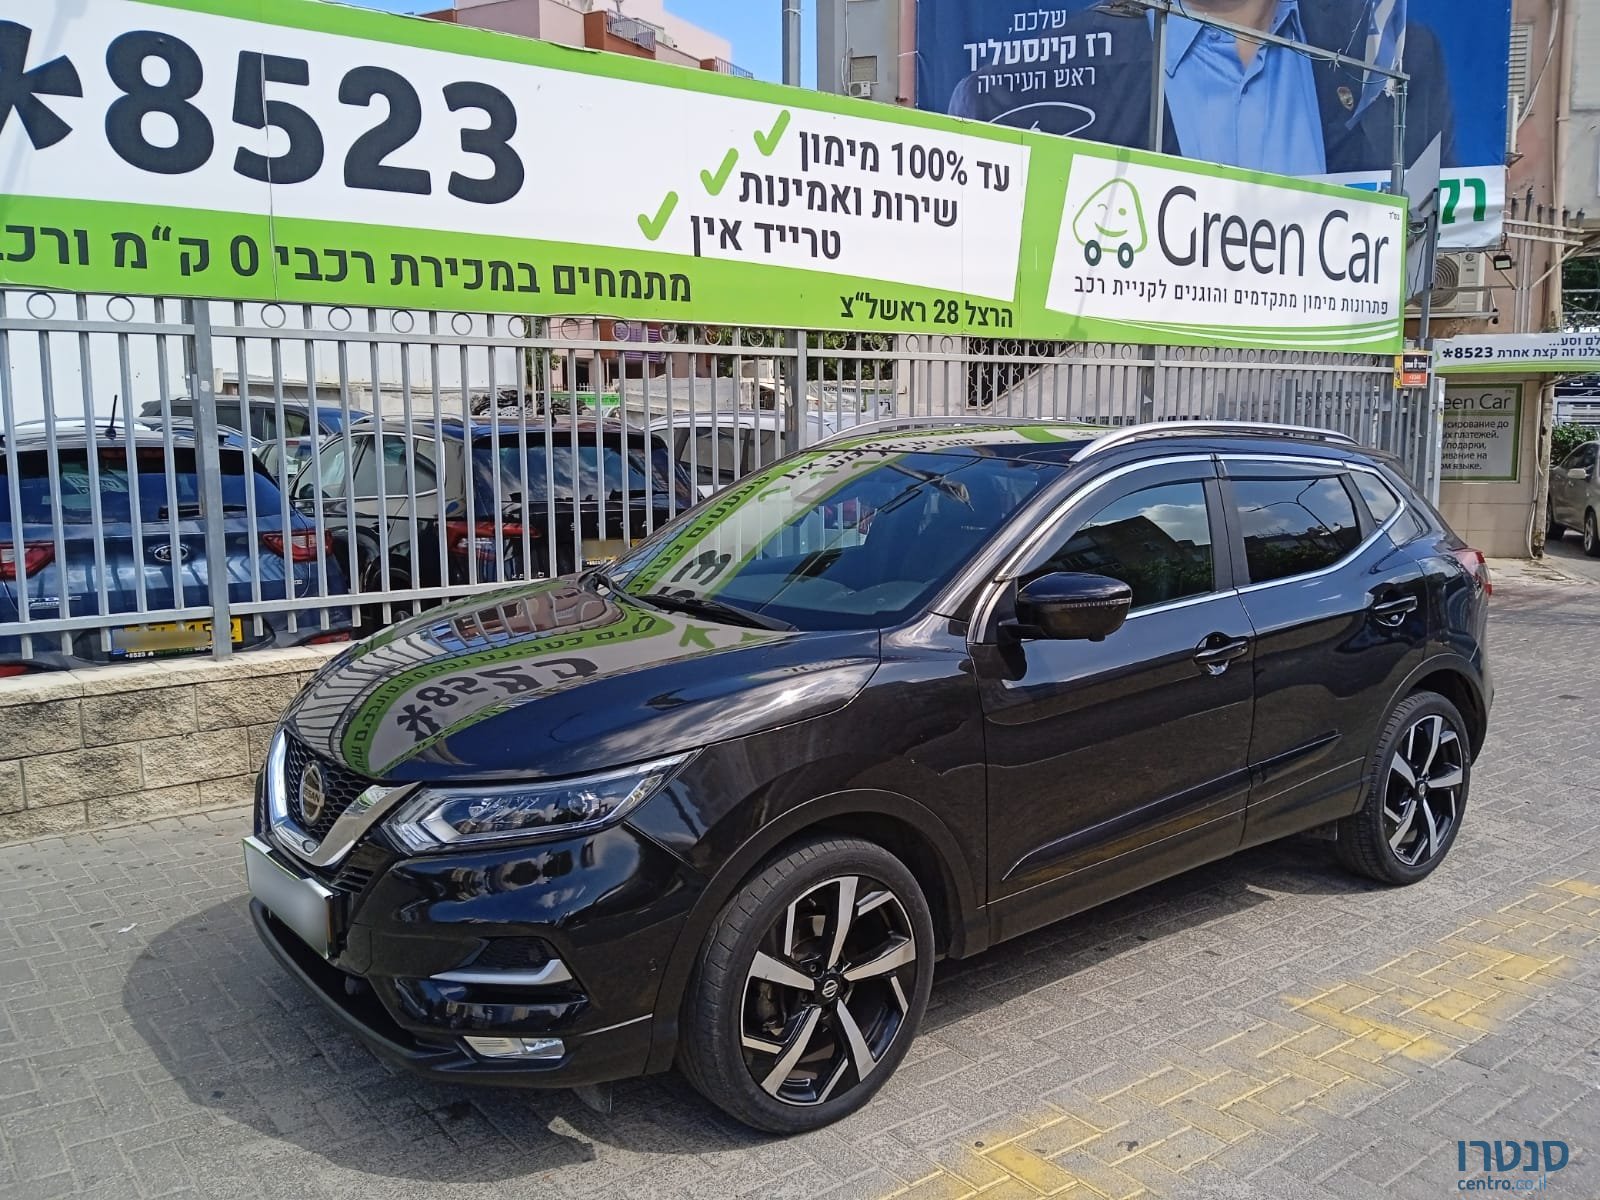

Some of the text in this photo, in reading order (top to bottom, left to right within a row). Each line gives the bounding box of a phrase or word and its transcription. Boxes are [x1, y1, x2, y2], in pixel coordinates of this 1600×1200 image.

[1008, 9, 1066, 34] שלכם,
[963, 32, 1113, 72] רז קינסטליך
[978, 66, 1096, 94] ראש העירייה
[800, 131, 1010, 192] עד 100% מימון
[739, 171, 957, 227] שירות ואמינות
[0, 225, 89, 266] ורכ
[691, 215, 841, 260] טרייד אין
[1158, 185, 1389, 285] Green Car
[230, 241, 259, 276] 0
[273, 245, 376, 284] רכבי
[390, 252, 540, 294] במכירת
[553, 264, 691, 302] מתמחים
[1074, 276, 1389, 316] פתרונות מימון מתקדמים והוגנים לקניית רכב
[932, 299, 959, 325] 28
[965, 299, 1013, 329] הרצל
[1479, 393, 1511, 410] Car
